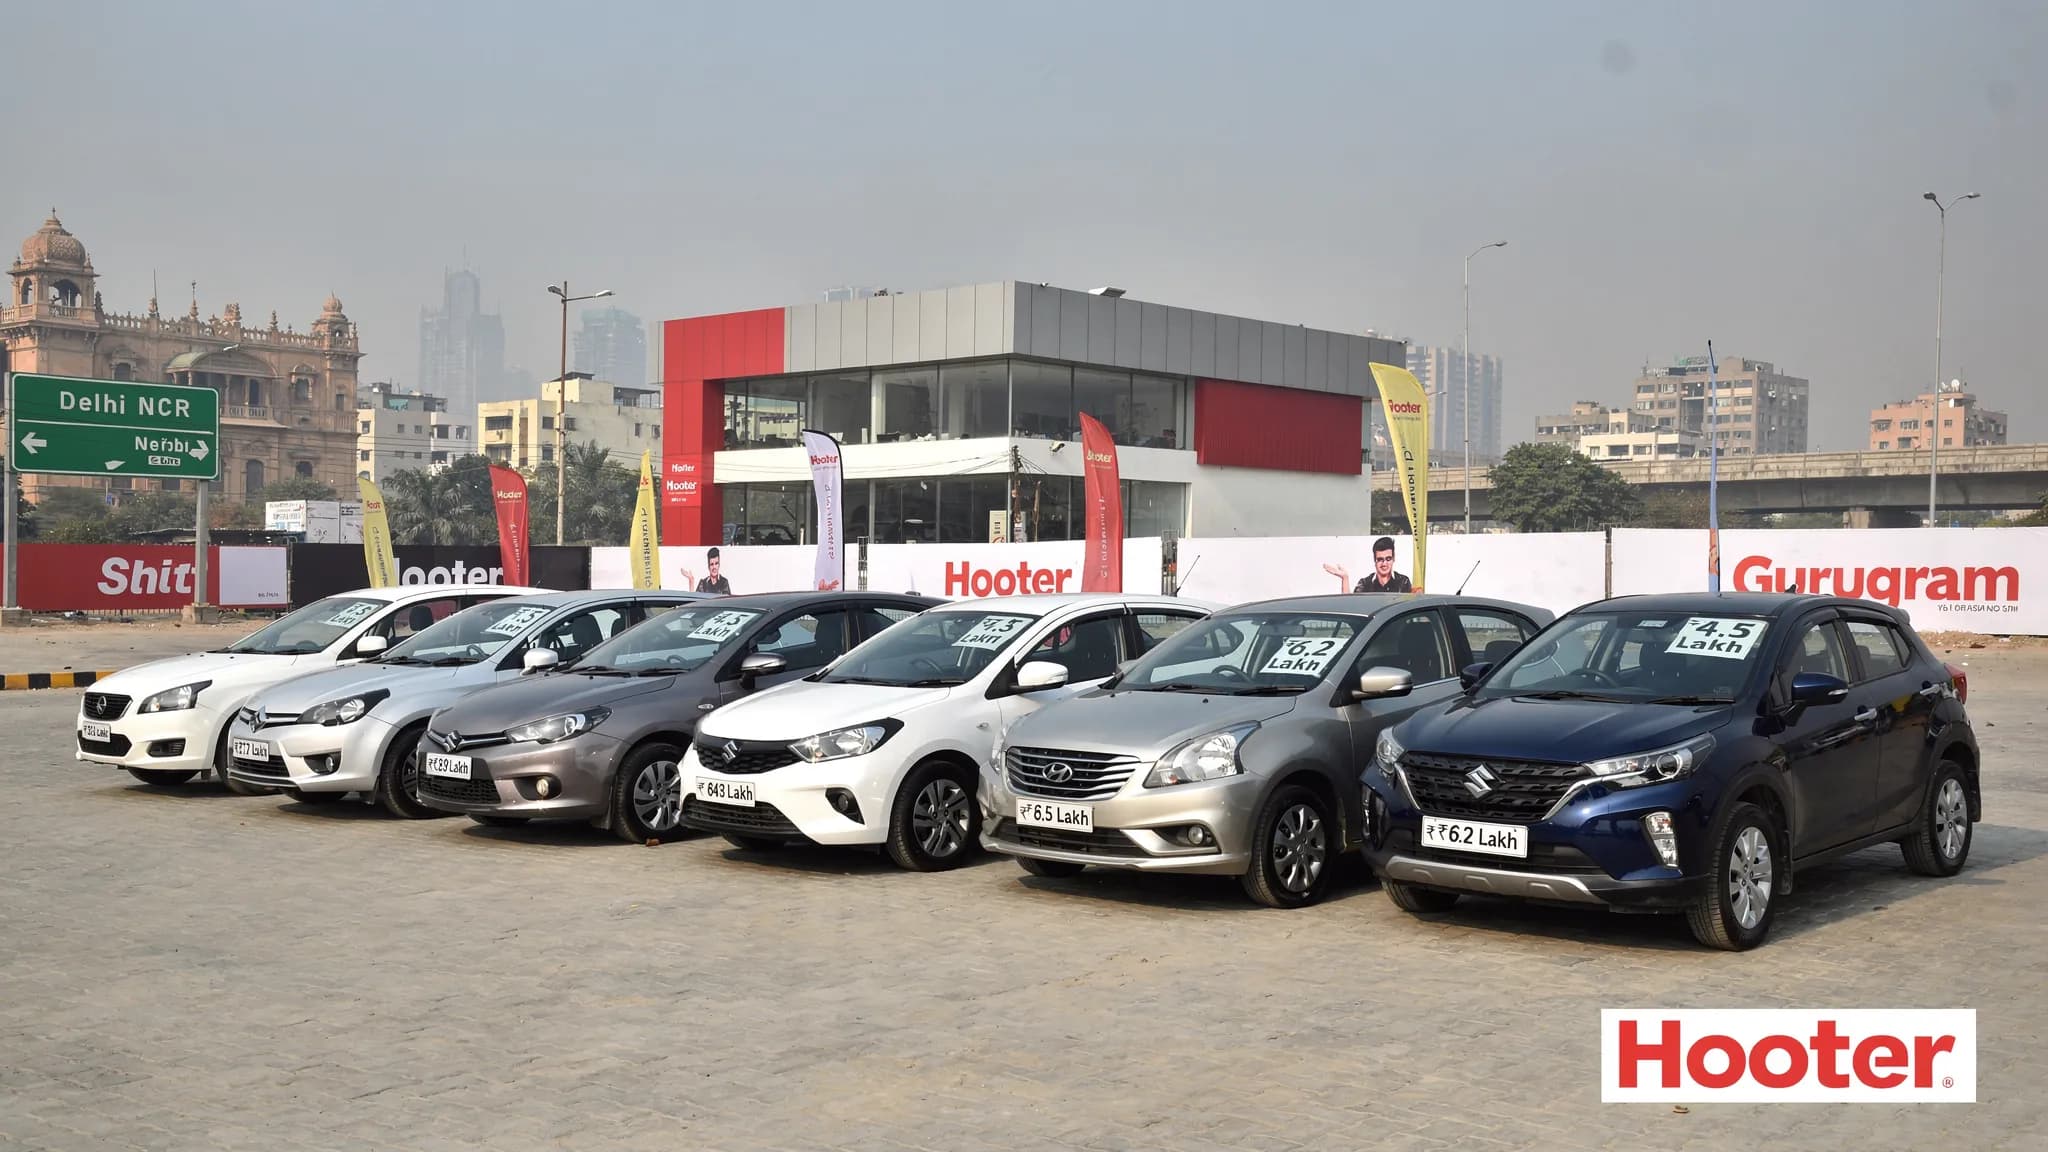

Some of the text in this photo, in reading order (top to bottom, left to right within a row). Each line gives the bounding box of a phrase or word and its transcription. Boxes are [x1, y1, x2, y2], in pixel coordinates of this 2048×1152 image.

[60, 390, 190, 418] Delhi NCR
[945, 561, 1072, 598] Hooter
[1733, 555, 2020, 609] Gurugram
[1676, 636, 1743, 653] Lakh
[1267, 658, 1320, 671] Lakh
[450, 759, 469, 774] Lakh
[707, 782, 725, 798] 643
[727, 784, 753, 801] Lakh
[1057, 806, 1089, 826] Lakh
[1479, 828, 1517, 850] Lakh
